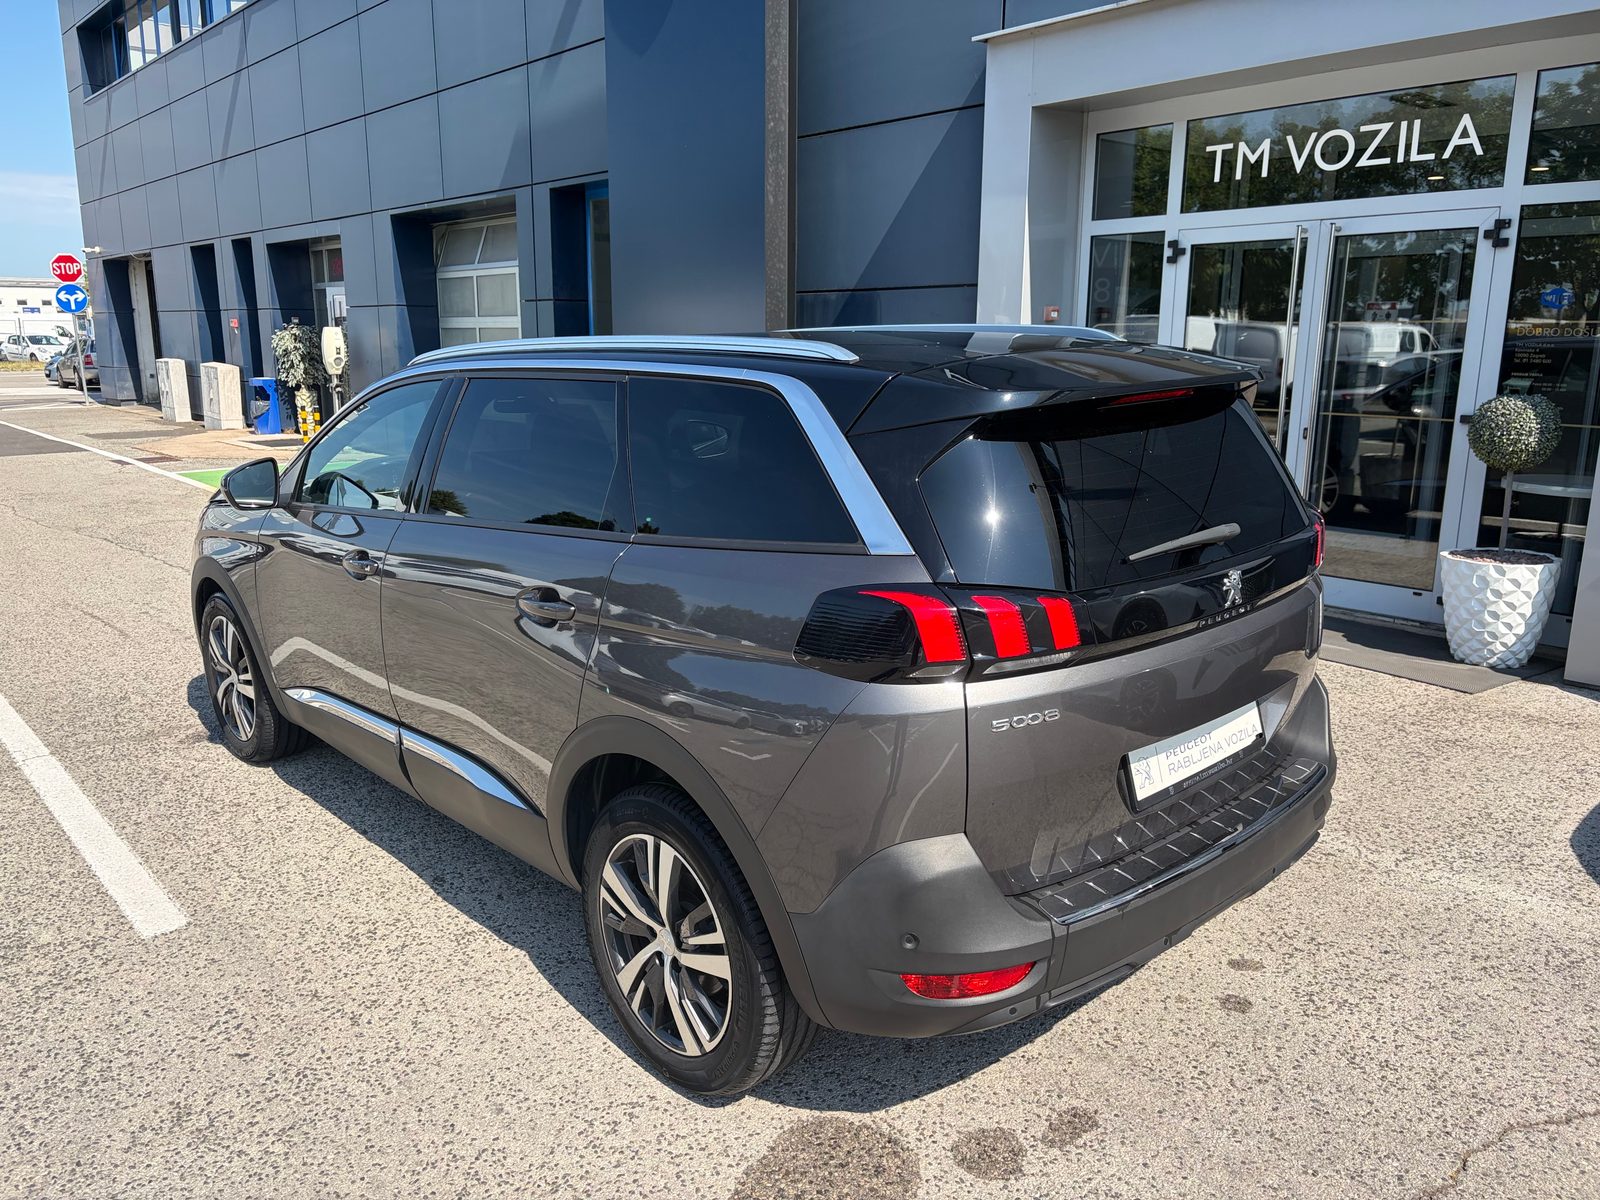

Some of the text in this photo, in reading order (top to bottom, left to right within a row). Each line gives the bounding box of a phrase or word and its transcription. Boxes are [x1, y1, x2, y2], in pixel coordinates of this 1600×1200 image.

[1206, 113, 1483, 183] TM VOZILA
[52, 262, 81, 275] STOP
[1516, 325, 1600, 337] DOBRO DOŠL
[1199, 603, 1252, 628] PEUGEOT
[991, 708, 1060, 733] 5008
[1165, 731, 1213, 760] PEUGEOT
[1167, 723, 1258, 775] RABLJENA VOZILA
